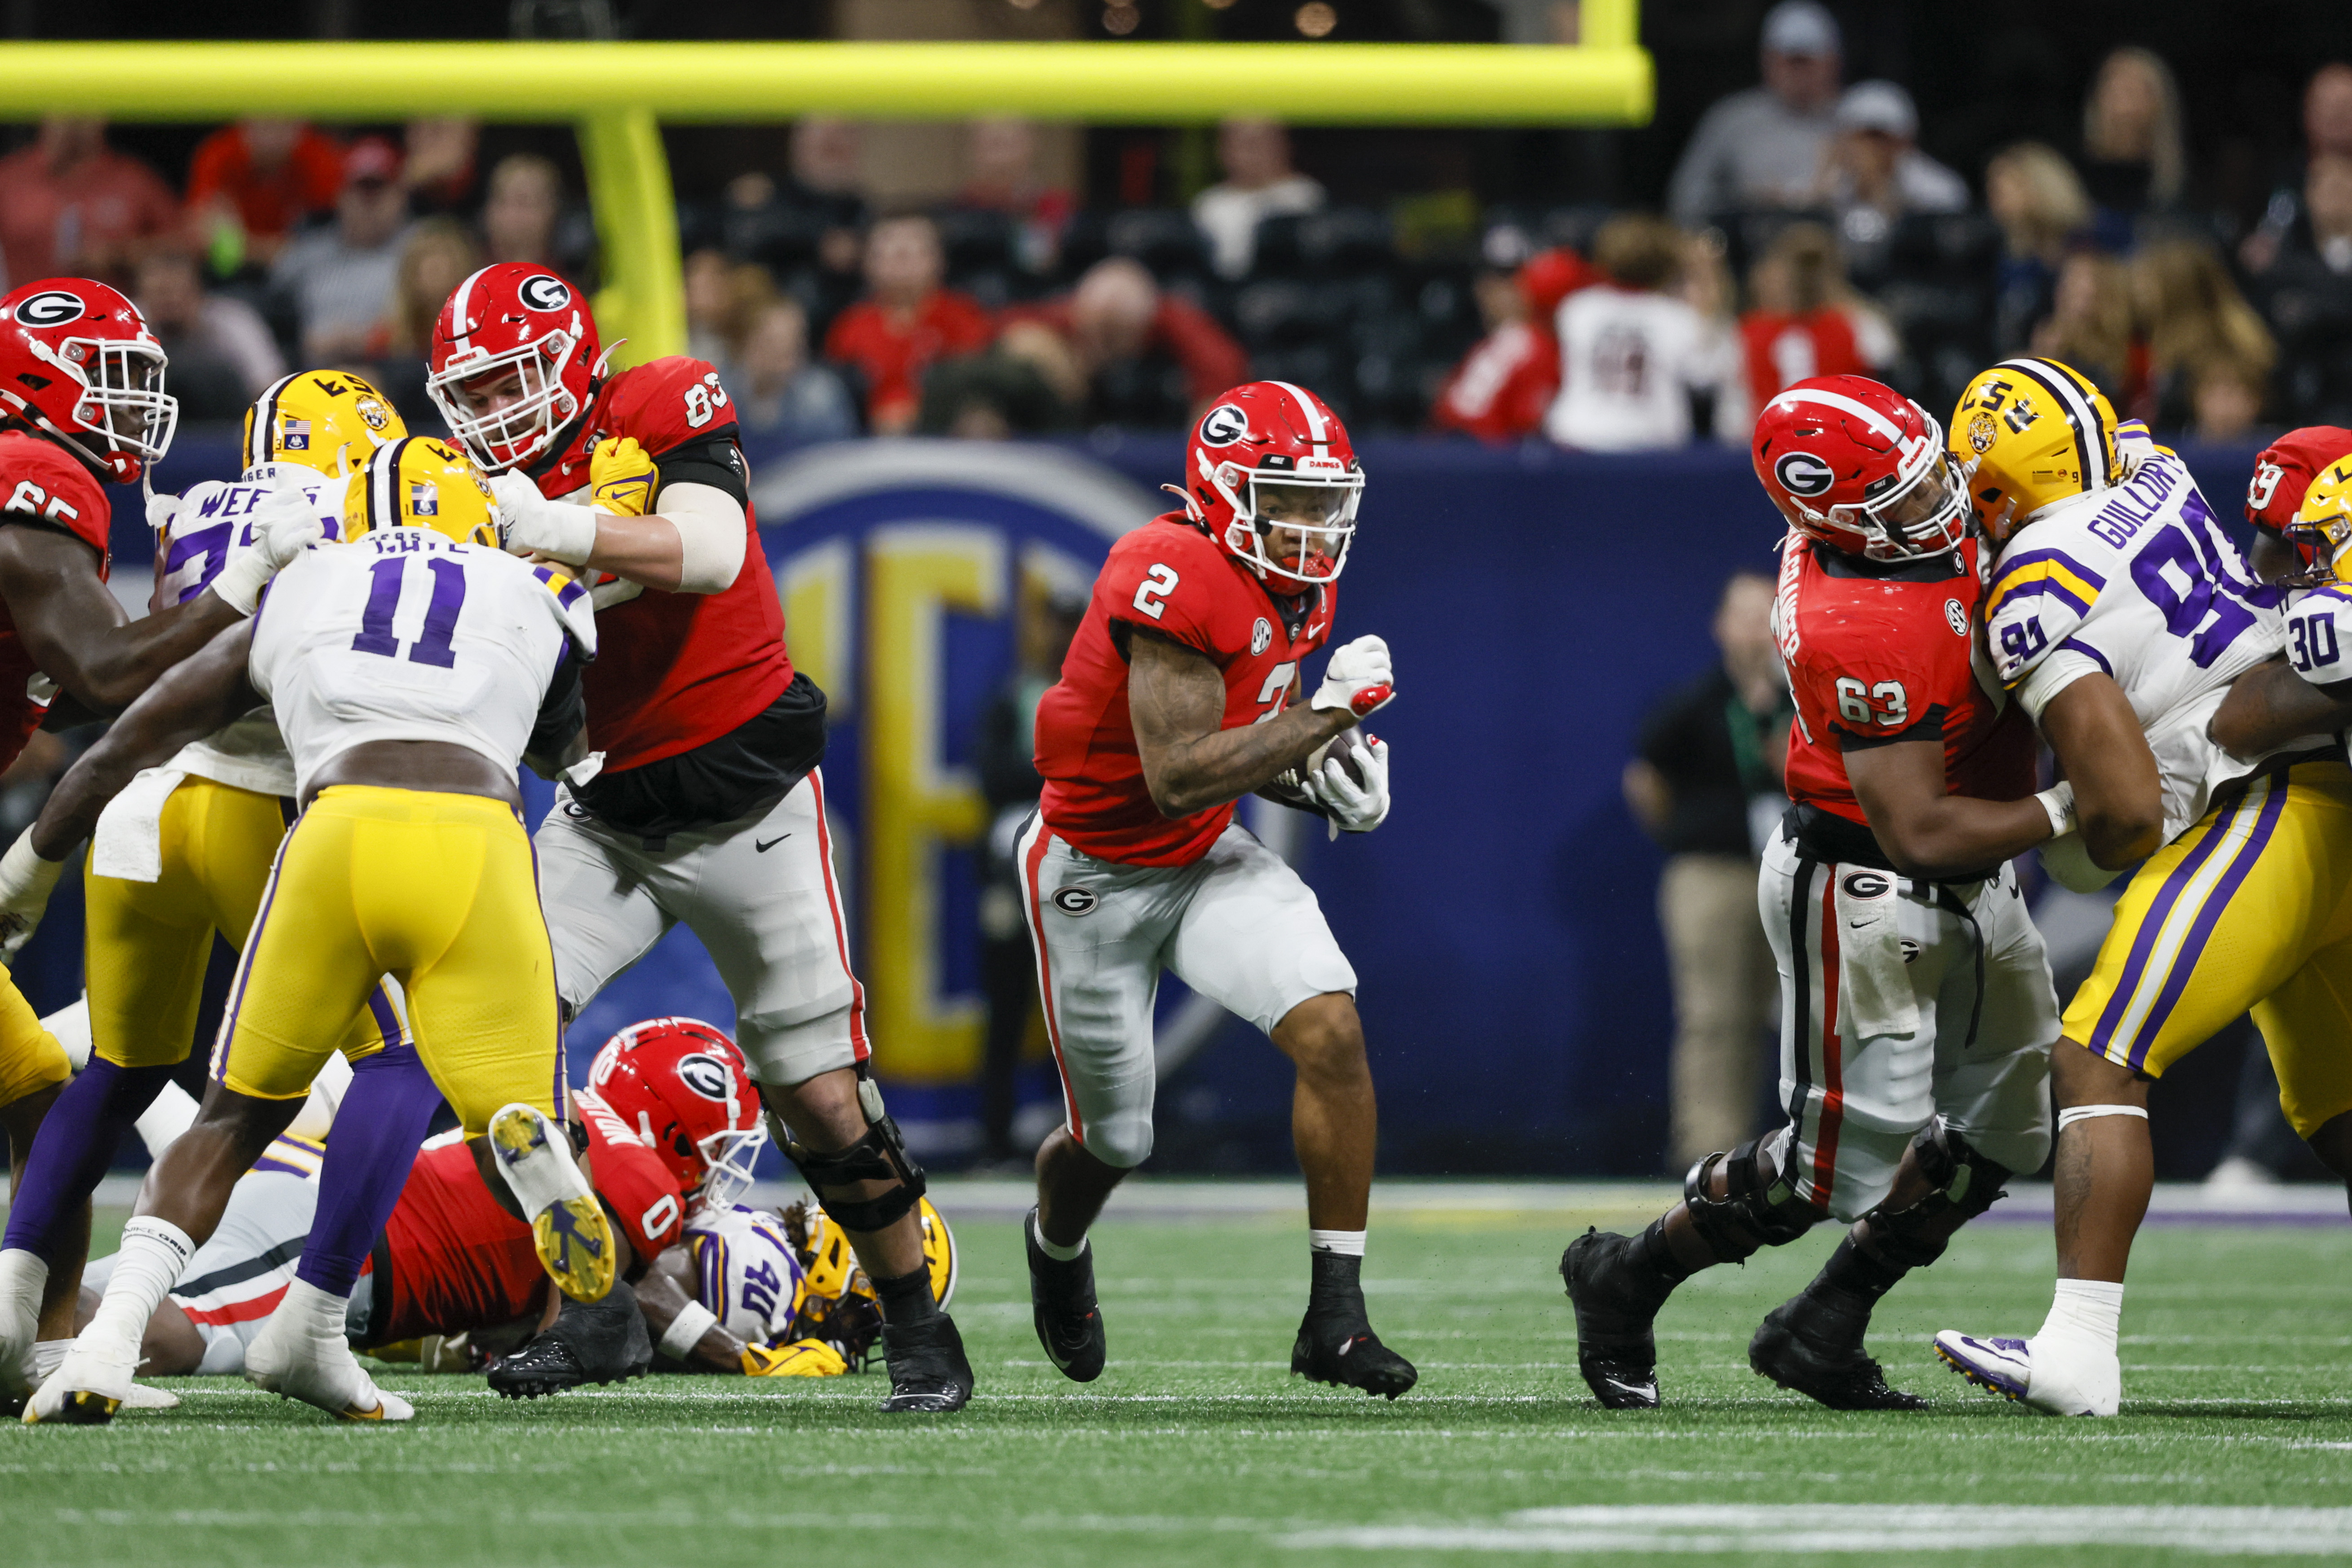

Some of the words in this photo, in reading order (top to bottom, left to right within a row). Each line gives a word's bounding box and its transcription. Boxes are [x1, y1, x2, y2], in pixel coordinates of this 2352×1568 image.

[15, 292, 84, 327] G
[519, 275, 569, 312] G
[684, 372, 728, 428] 83
[1200, 405, 1248, 447] G
[1775, 452, 1834, 497] G
[2087, 455, 2183, 549] GUILLORY
[351, 556, 466, 669] 11
[1133, 563, 1179, 620] 2
[2289, 613, 2340, 671] 30
[1836, 676, 1908, 726] 63
[1053, 887, 1098, 914] G
[1843, 873, 1889, 898] G
[641, 1194, 679, 1241] 0
[741, 1259, 781, 1325] 40
